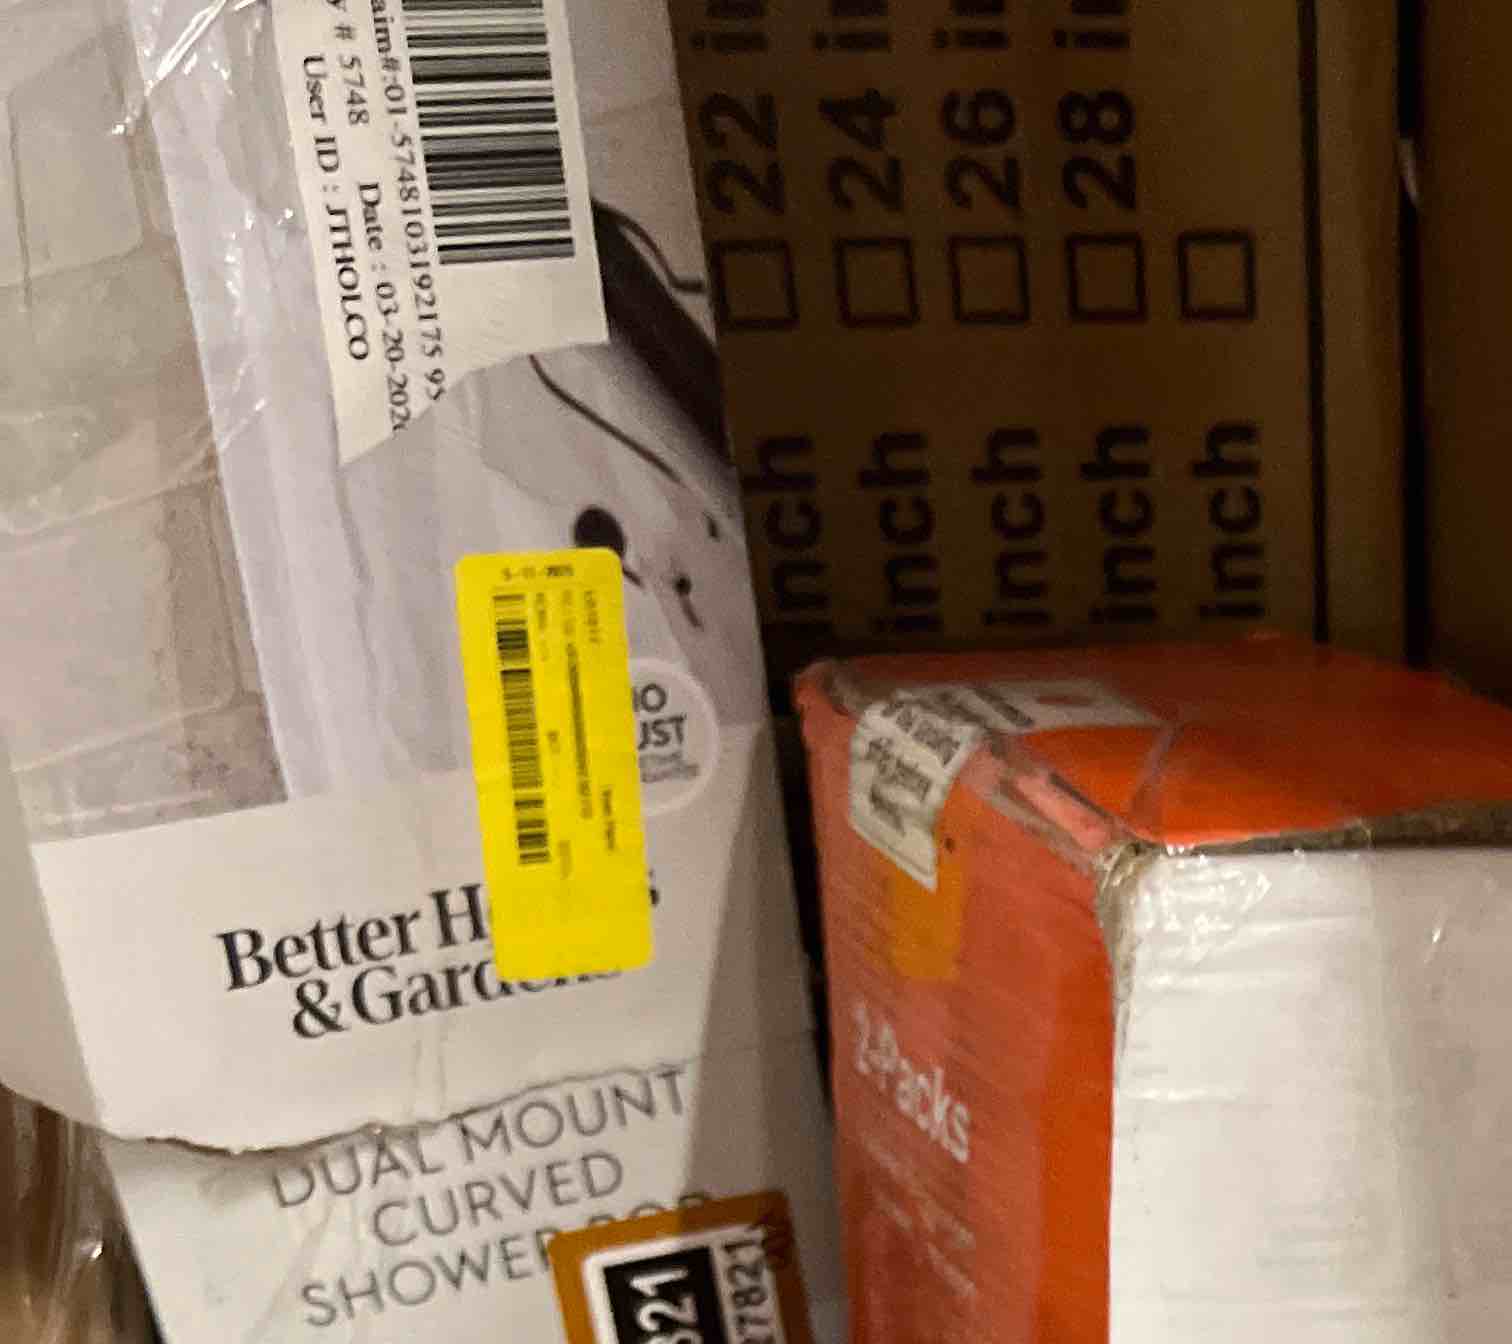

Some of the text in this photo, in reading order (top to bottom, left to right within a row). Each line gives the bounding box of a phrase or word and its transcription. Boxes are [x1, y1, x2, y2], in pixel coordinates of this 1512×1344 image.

[302, 55, 329, 125] User
[817, 88, 905, 213] 24
[940, 89, 1022, 211] 26
[1056, 88, 1138, 211] 28
[339, 54, 370, 126] 5748
[357, 181, 384, 253] Date
[697, 91, 785, 215] 22
[858, 431, 944, 633] inch
[970, 427, 1054, 628] inch
[1079, 424, 1159, 625] inch
[1191, 421, 1267, 622] inch
[216, 903, 422, 993] Better
[291, 957, 621, 1041] & Gard
[456, 1064, 690, 1160] MOUNT
[371, 1149, 625, 1249] CURVED
